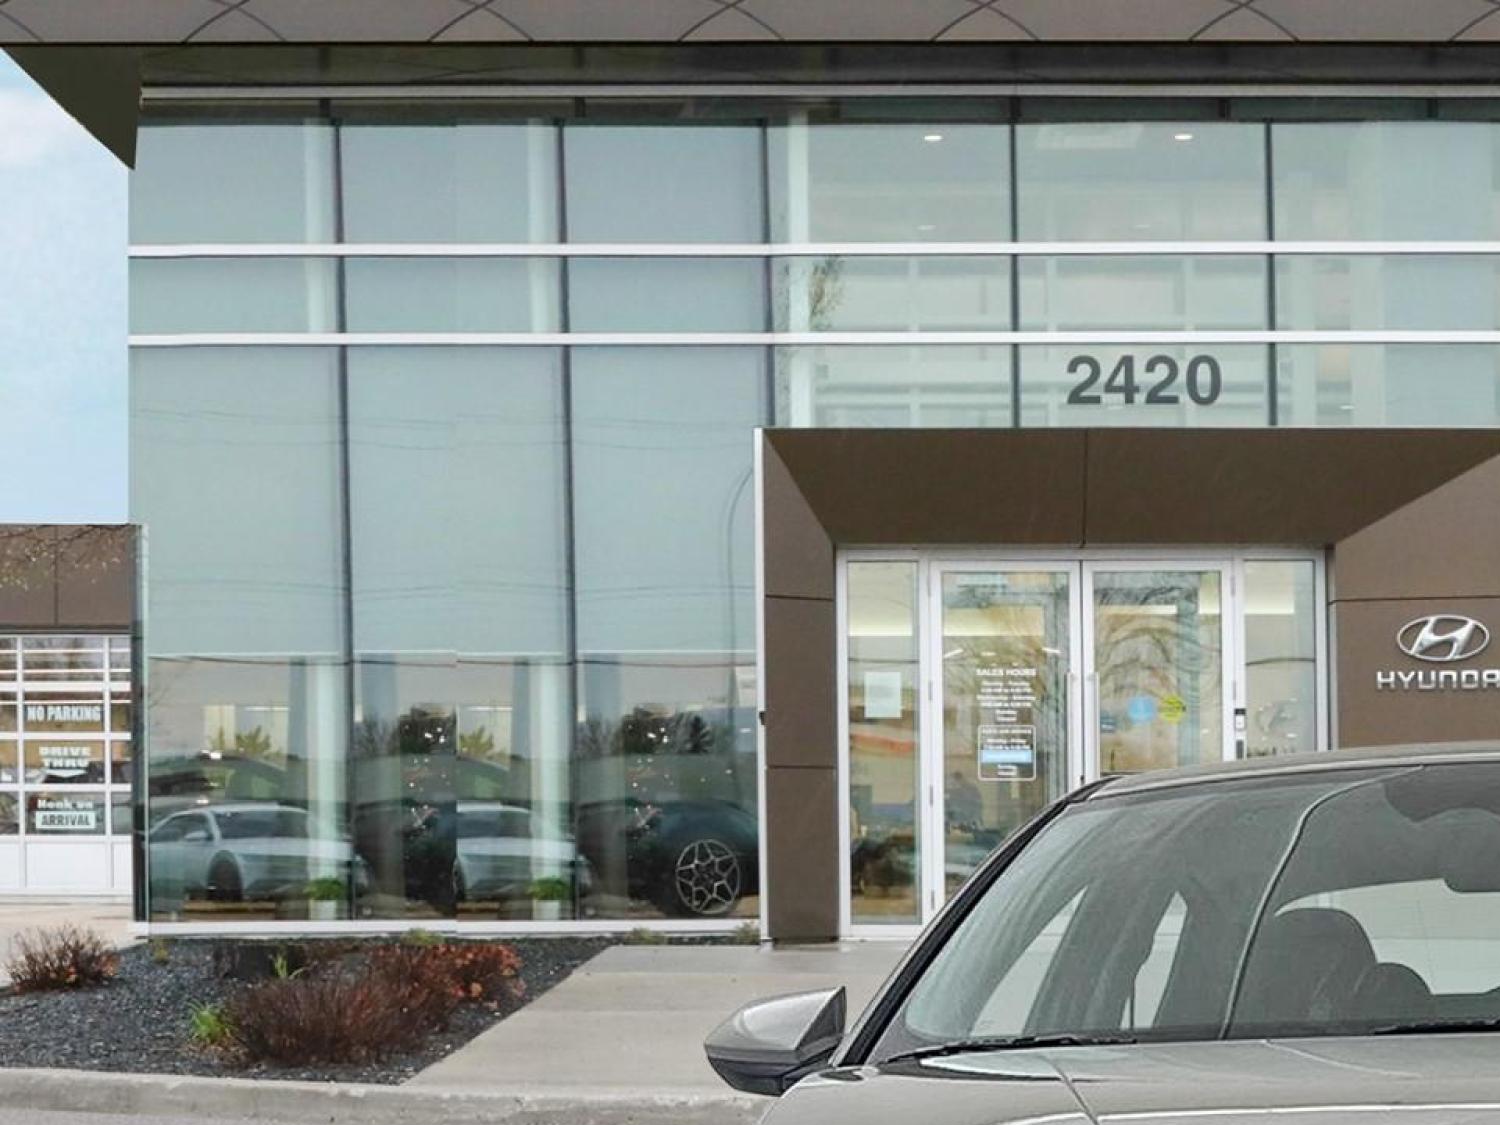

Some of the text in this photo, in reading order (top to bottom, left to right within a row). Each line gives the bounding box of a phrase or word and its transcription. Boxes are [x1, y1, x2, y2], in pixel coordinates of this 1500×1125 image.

[1067, 354, 1221, 405] 2420
[27, 705, 101, 721] NO PARKING
[41, 813, 90, 826] ARRIVAL
